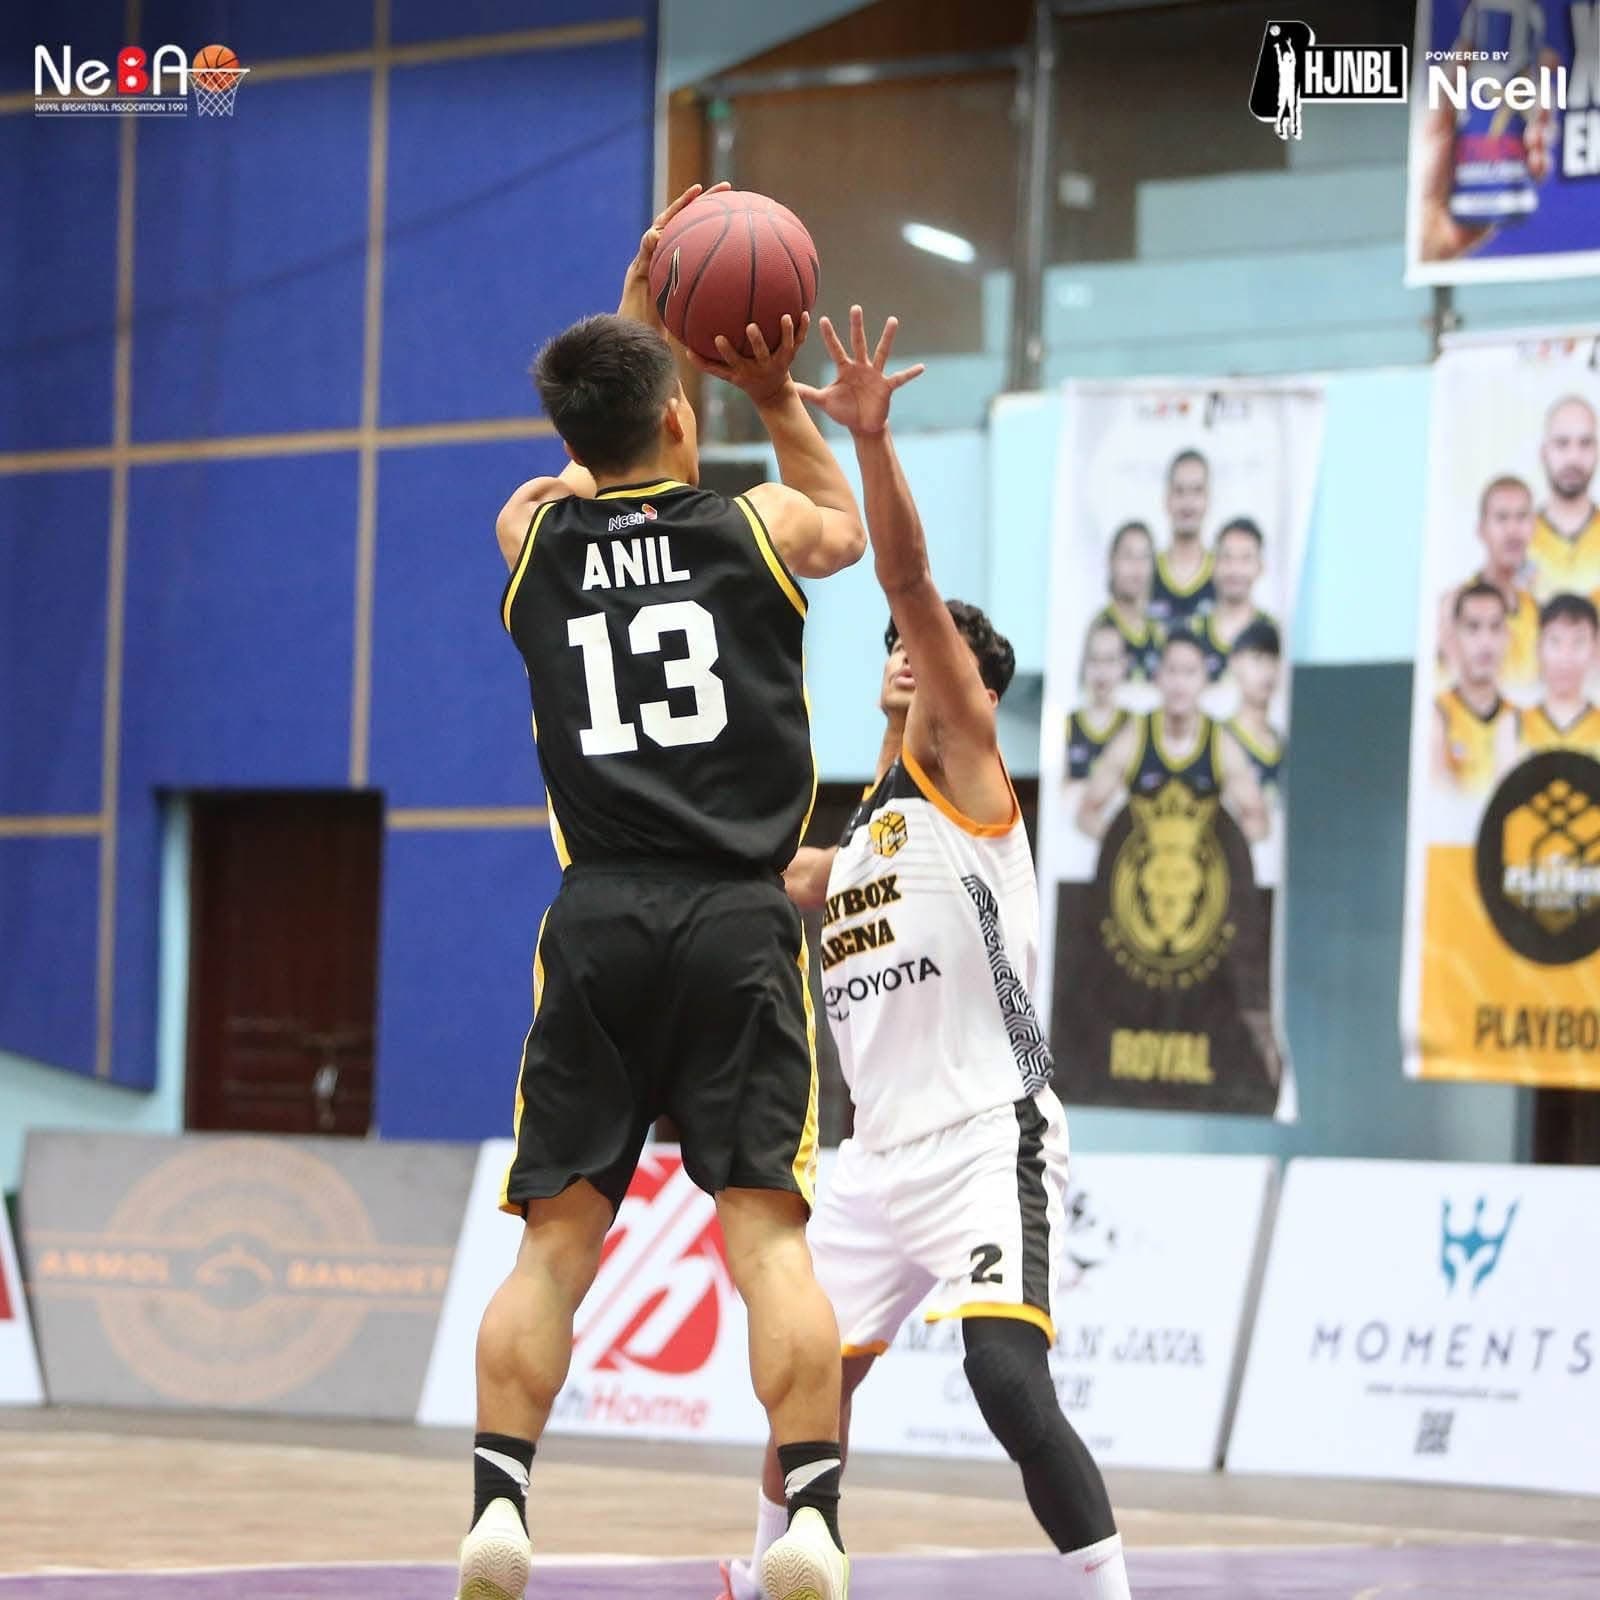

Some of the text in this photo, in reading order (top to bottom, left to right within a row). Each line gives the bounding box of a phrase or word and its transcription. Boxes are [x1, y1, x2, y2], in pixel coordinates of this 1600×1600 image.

[582, 535, 691, 591] ANIL
[567, 600, 728, 756] 13
[823, 874, 902, 927] AYBOX
[820, 917, 895, 972] ARENA
[847, 956, 942, 1001] OYOTA
[1475, 1003, 1600, 1053] PLAYBO
[1110, 1028, 1214, 1085] ROYAL
[969, 1243, 1004, 1285] 2
[1308, 1319, 1594, 1375] MOMENTS
